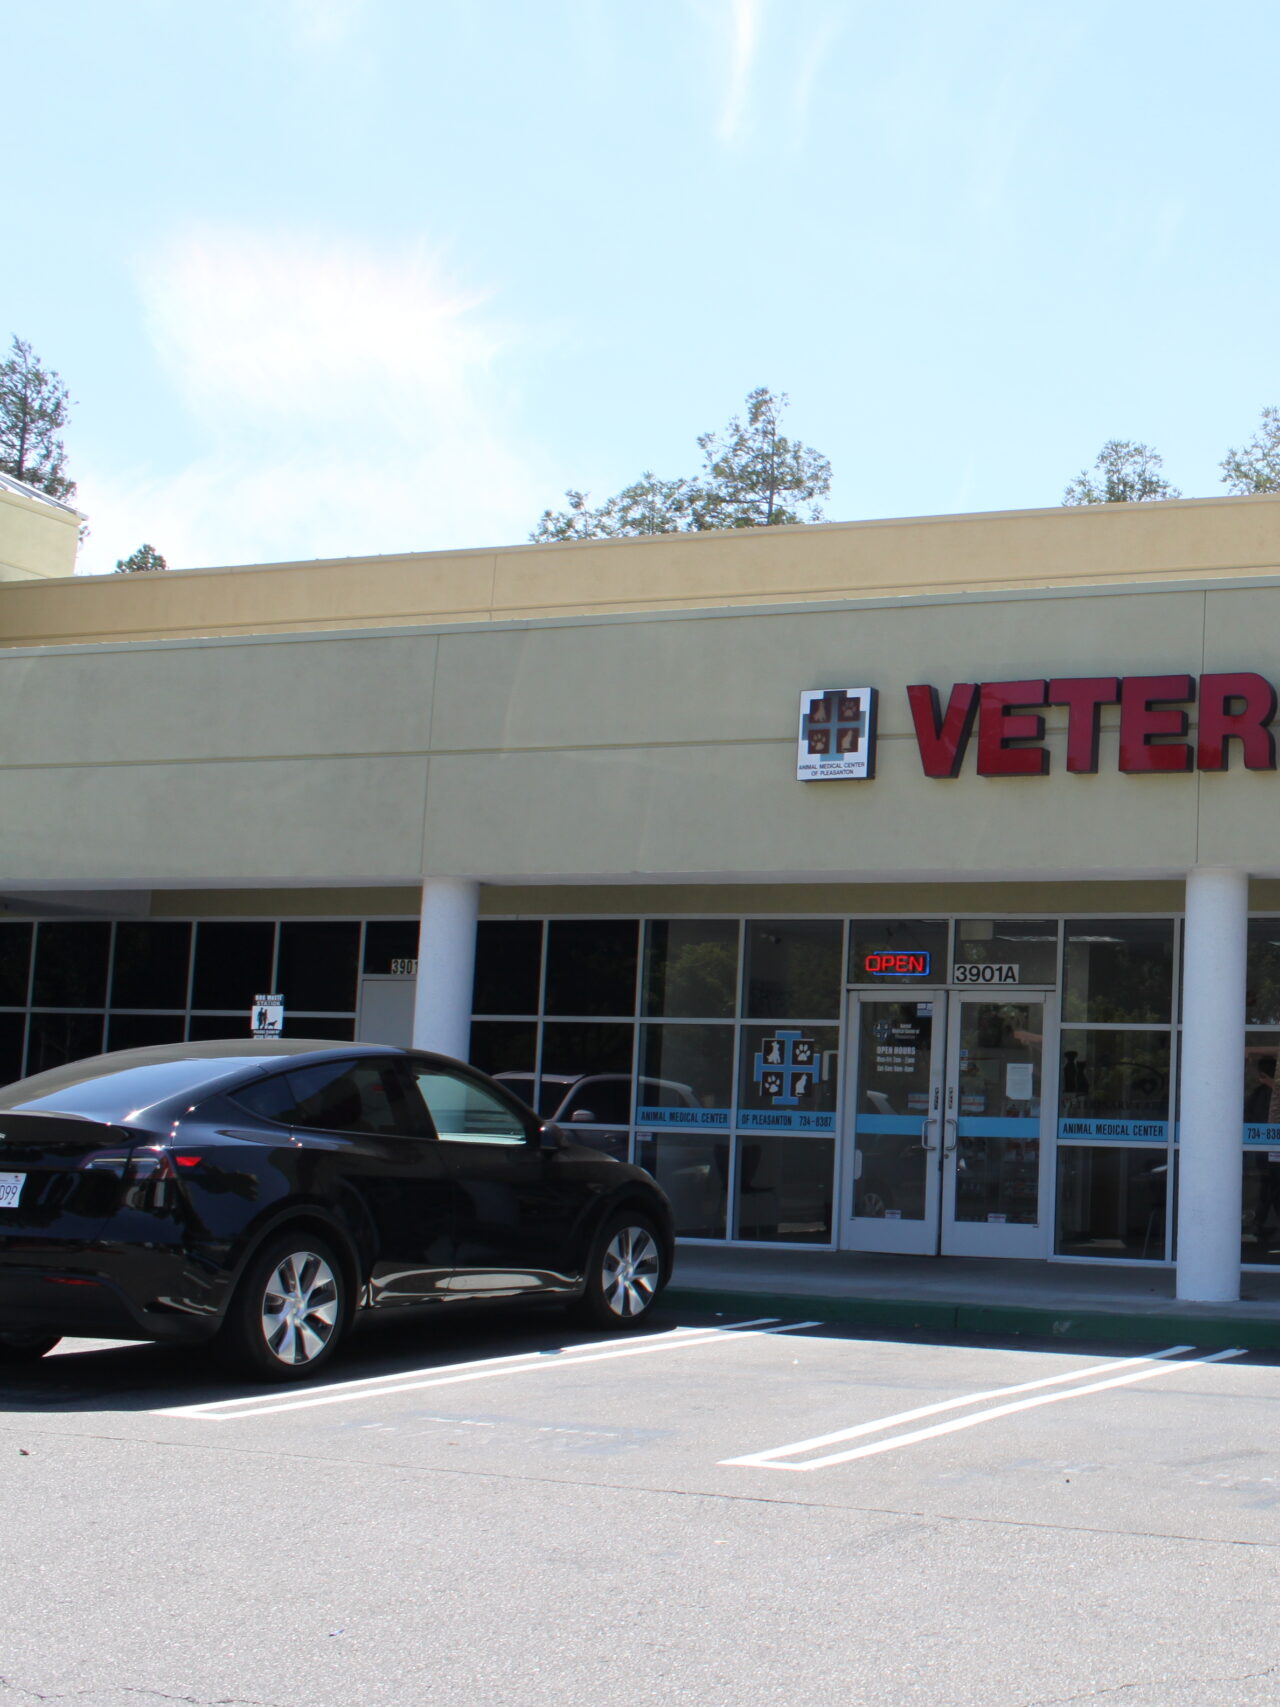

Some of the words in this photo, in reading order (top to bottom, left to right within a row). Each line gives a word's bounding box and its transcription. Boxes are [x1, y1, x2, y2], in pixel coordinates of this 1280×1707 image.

[865, 954, 924, 972] OPEN
[956, 965, 1016, 982] 3901A
[641, 1111, 667, 1122] ANIMAL
[669, 1112, 698, 1123] MEDICAL
[701, 1113, 728, 1124] CENTER
[741, 1114, 751, 1125] OF
[752, 1114, 792, 1126] PLEASANTON
[799, 1115, 832, 1127] 734-8387
[1063, 1123, 1093, 1135] ANIMAL
[1096, 1124, 1130, 1136] MEDICAL
[1133, 1125, 1164, 1137] CENTER
